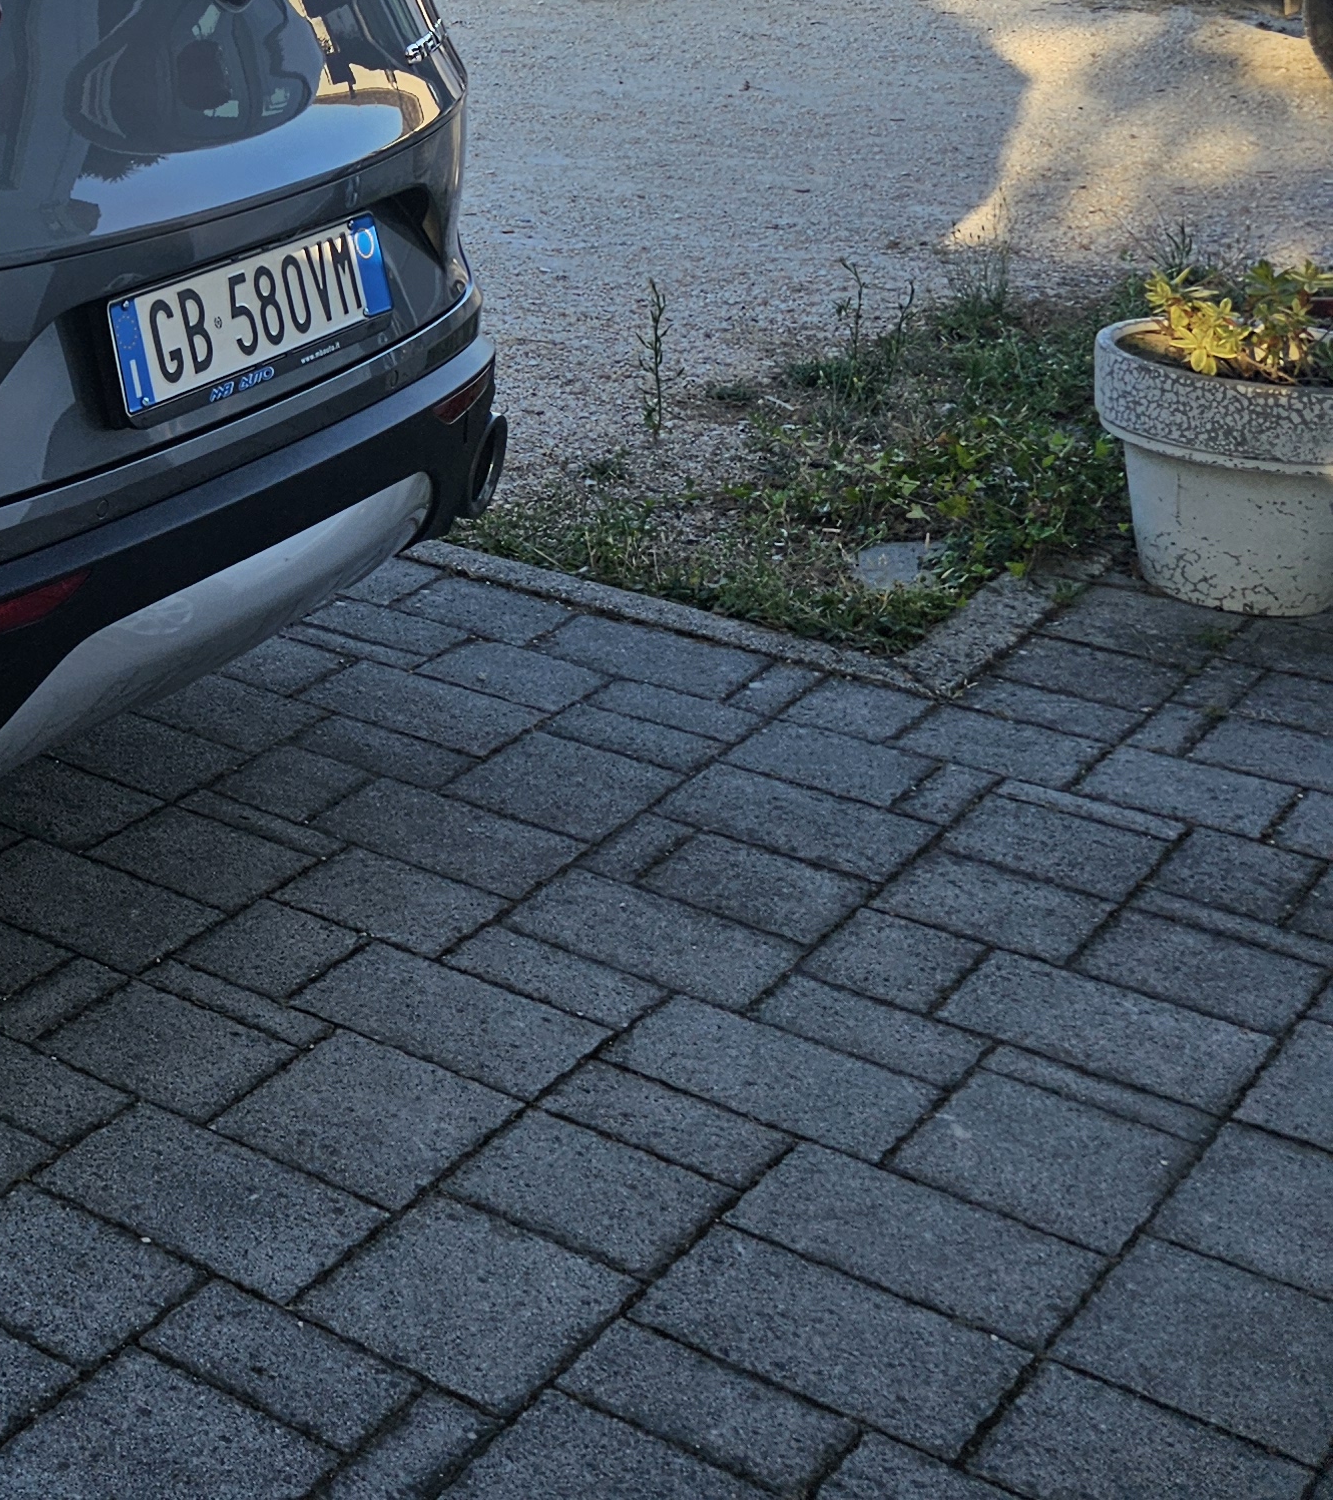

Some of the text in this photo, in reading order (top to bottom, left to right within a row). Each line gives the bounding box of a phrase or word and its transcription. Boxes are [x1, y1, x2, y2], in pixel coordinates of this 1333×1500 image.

[149, 287, 213, 384] GB
[228, 231, 363, 356] 580VM
[300, 341, 341, 364] www.mbauto.it
